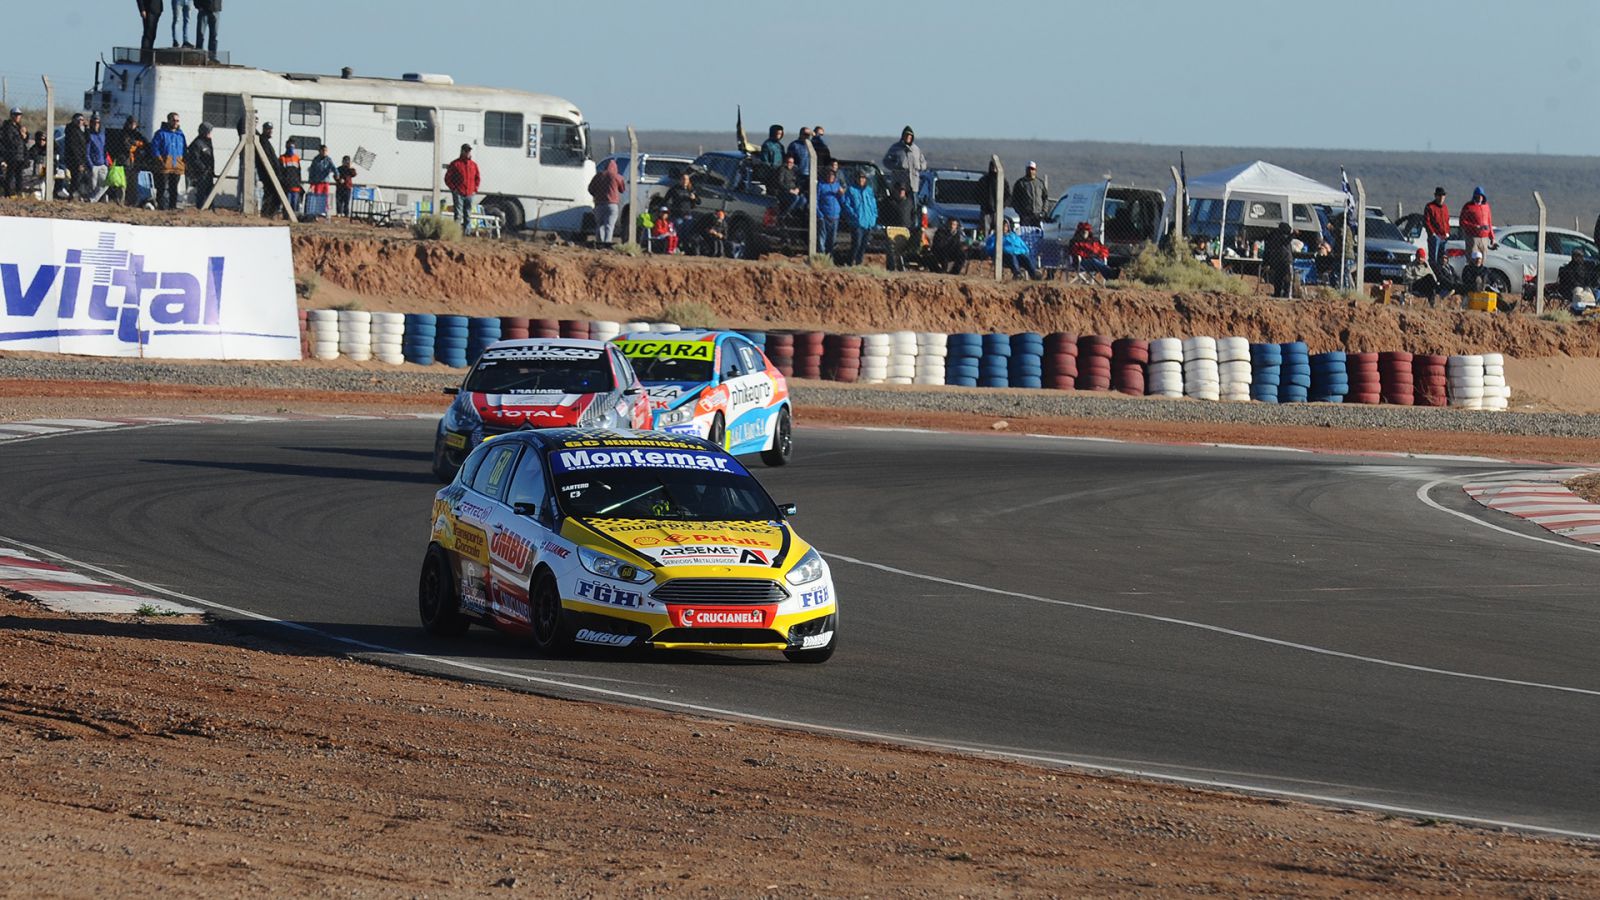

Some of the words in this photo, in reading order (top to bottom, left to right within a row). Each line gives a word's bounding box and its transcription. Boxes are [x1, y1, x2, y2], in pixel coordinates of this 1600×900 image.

[0, 231, 225, 345] vittal
[617, 342, 707, 358] UCARA
[492, 410, 565, 418] TOTAL
[564, 440, 600, 449] GC
[603, 439, 688, 449] NEUMATICOS
[560, 449, 727, 470] Montemar
[660, 546, 739, 556] ARSEMET
[577, 581, 640, 607] FGH
[696, 612, 762, 623] CRUCIANELLI
[576, 628, 628, 645] OMBU
